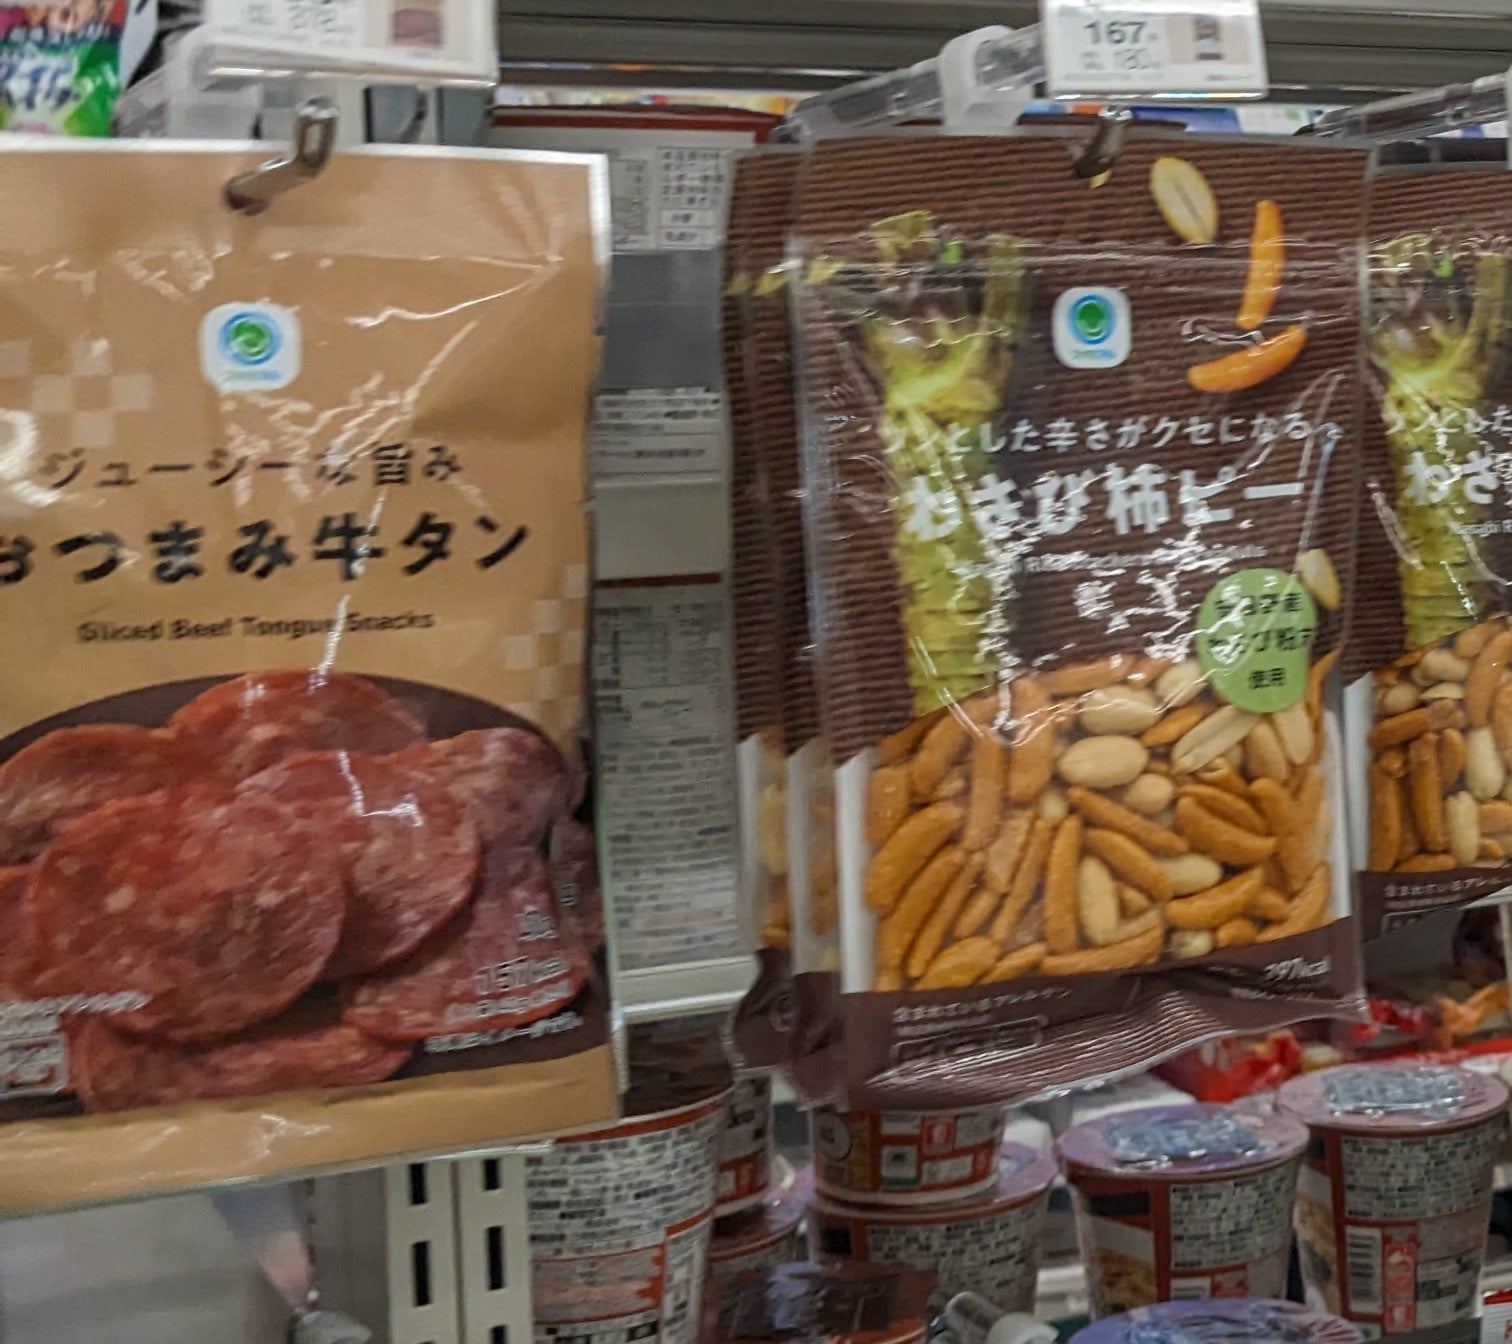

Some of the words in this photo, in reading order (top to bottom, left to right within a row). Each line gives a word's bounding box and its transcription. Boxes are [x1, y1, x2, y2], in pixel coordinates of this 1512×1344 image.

[1083, 20, 1148, 45] 167
[77, 621, 165, 644] Sliced
[172, 617, 232, 641] Beef
